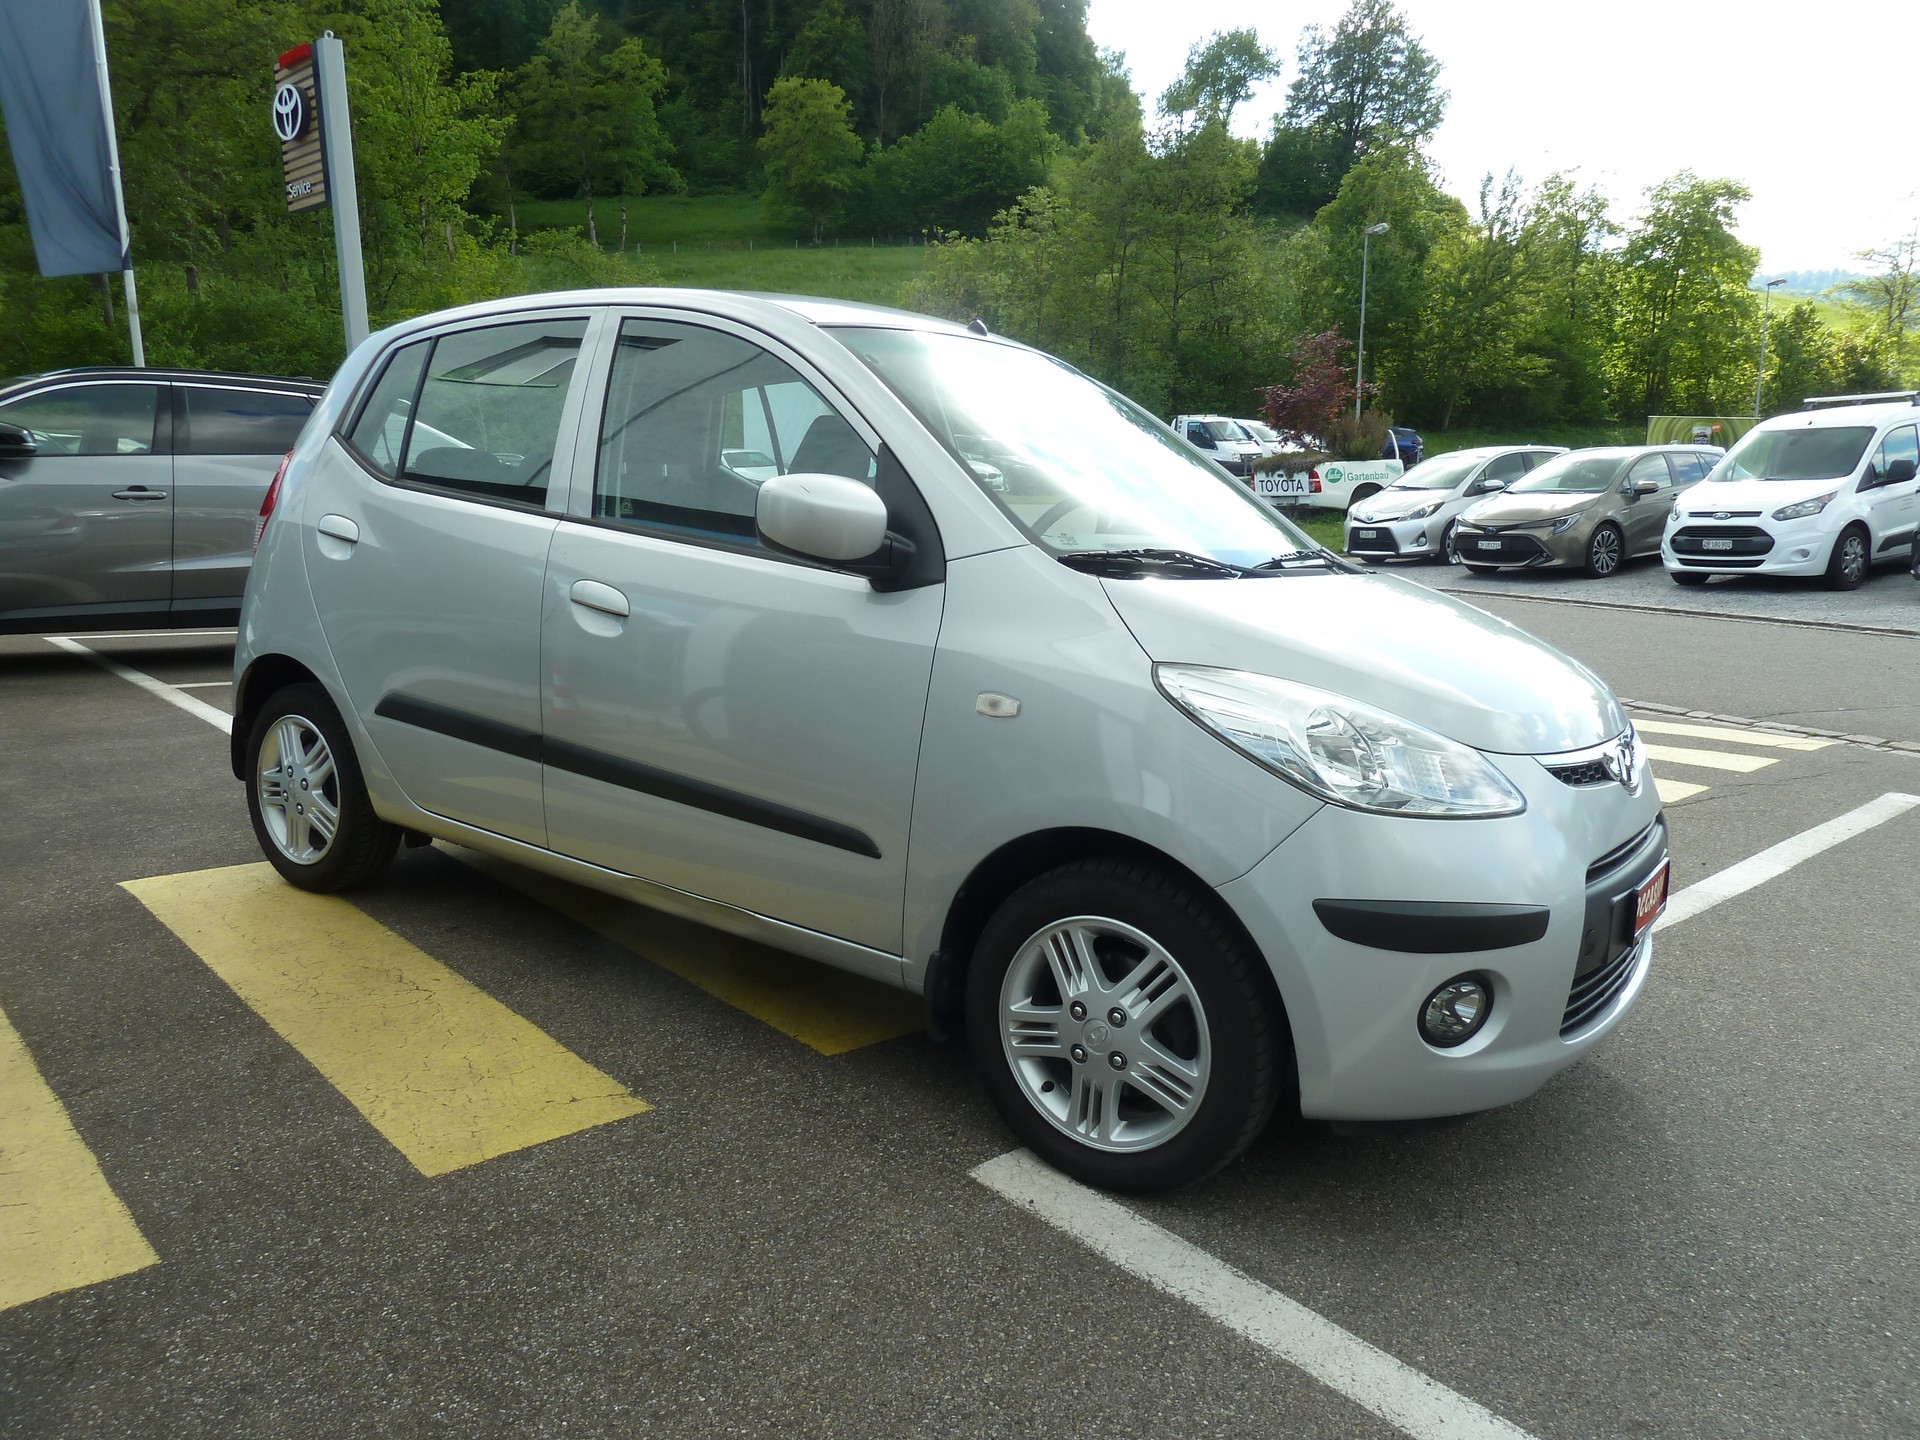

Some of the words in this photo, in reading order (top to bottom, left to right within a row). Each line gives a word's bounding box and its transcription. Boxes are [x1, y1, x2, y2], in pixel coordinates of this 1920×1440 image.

[289, 181, 310, 198] Service
[1347, 471, 1389, 481] Gartenbau
[1259, 480, 1304, 492] TOYOTA
